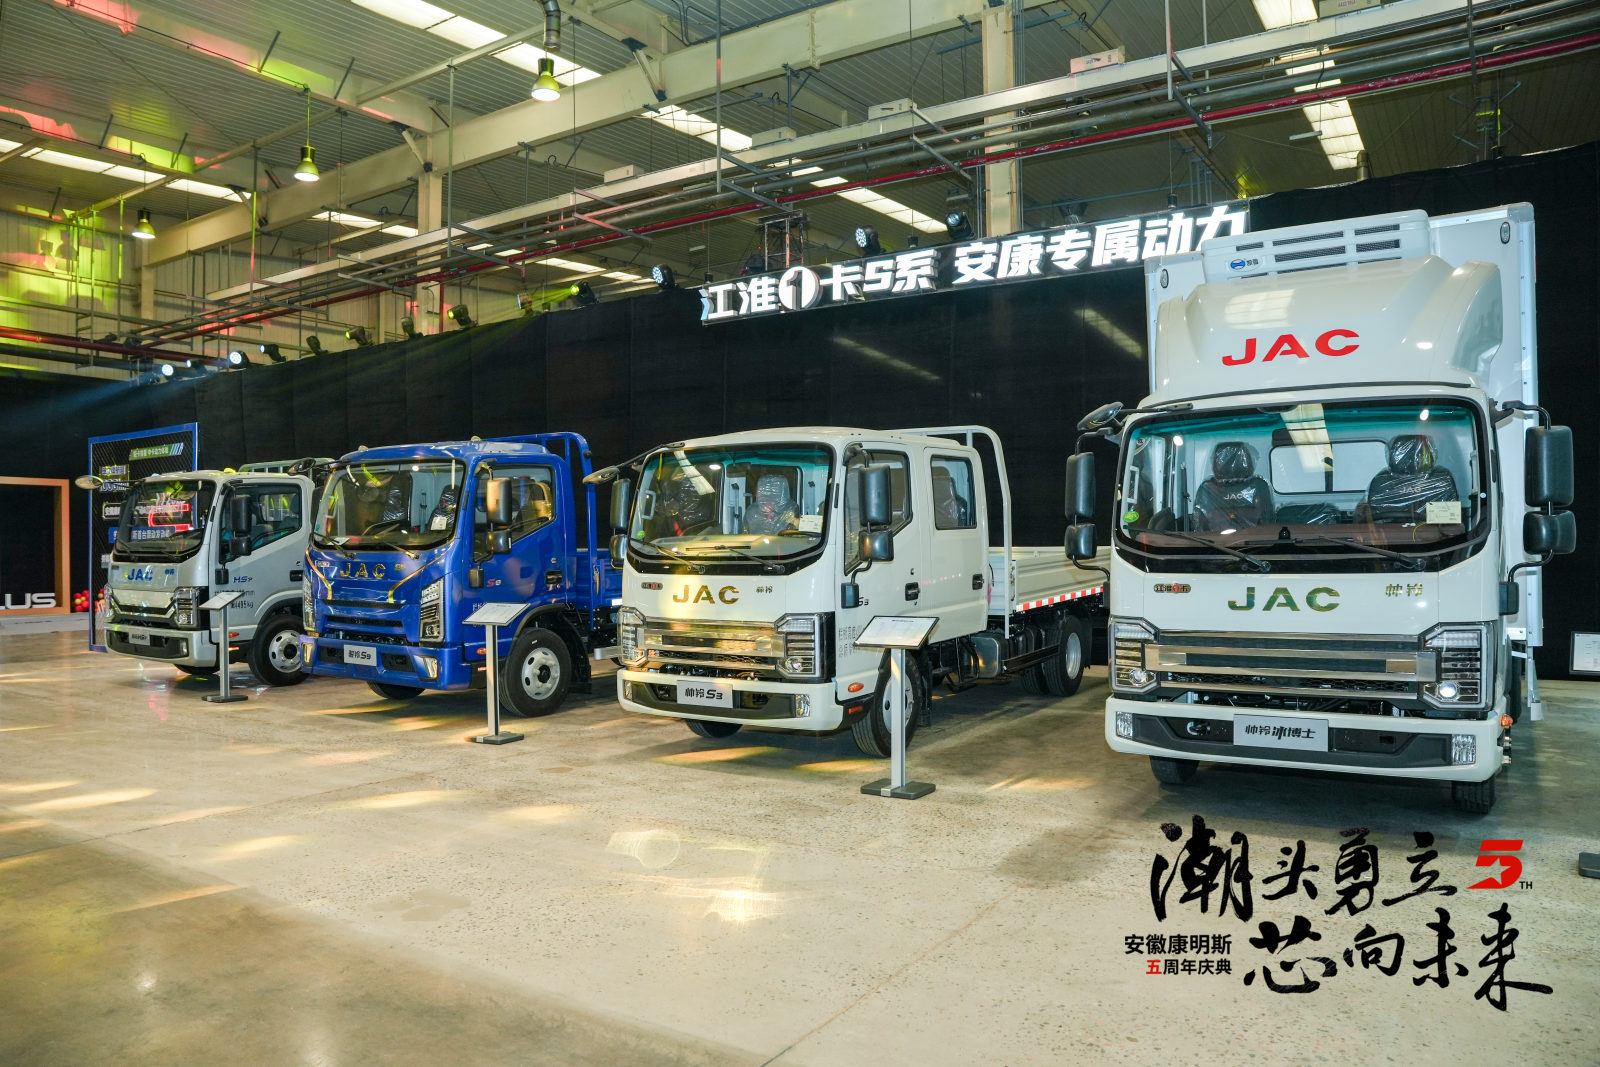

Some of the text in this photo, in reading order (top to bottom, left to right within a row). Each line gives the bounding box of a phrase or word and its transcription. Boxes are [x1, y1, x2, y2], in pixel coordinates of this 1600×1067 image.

[952, 205, 1248, 284] 安康专属动力
[1222, 328, 1360, 367] JAC
[127, 568, 153, 581] JAC
[339, 562, 386, 578] JAC
[0, 592, 56, 610] US
[672, 584, 740, 605] JAC
[1227, 586, 1340, 612] JAC
